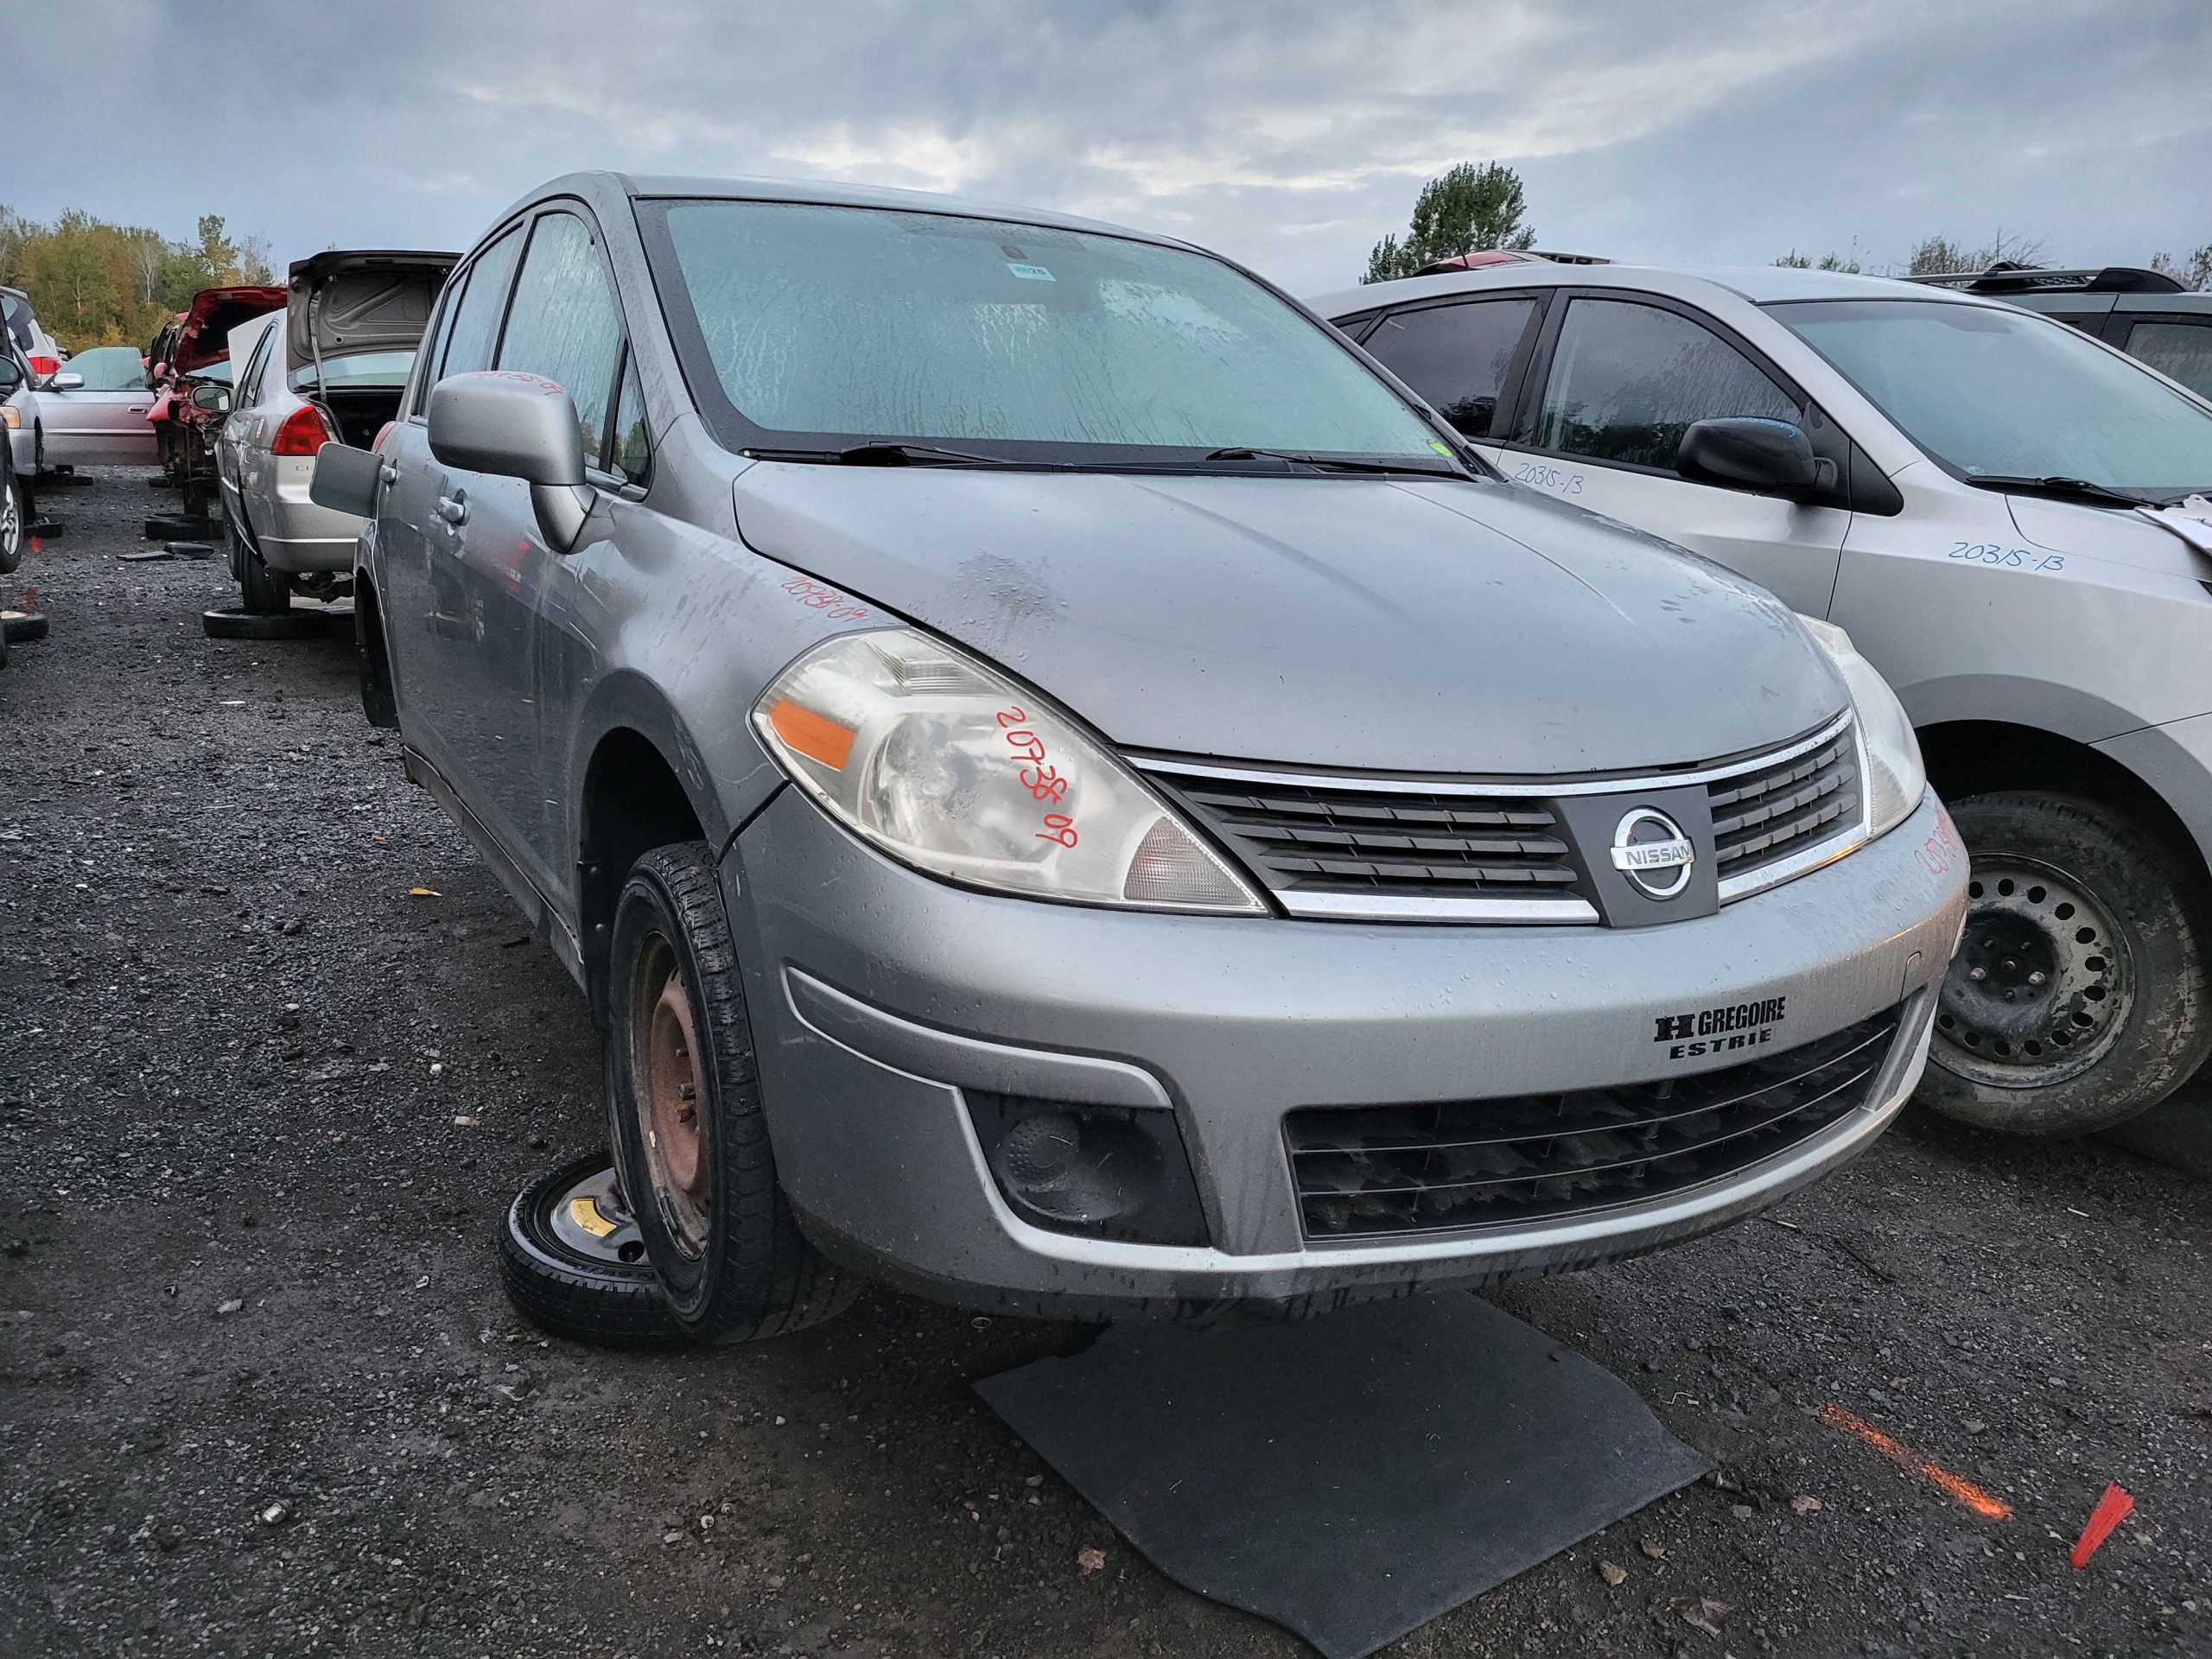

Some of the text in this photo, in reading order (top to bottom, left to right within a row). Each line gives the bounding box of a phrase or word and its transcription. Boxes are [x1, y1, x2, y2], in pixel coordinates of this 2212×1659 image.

[1514, 462, 1585, 494] 20315-13
[1948, 542, 2065, 571] 20315-13
[1624, 845, 1690, 866] NISSAN
[1669, 1027, 1772, 1060] ESTRIE
